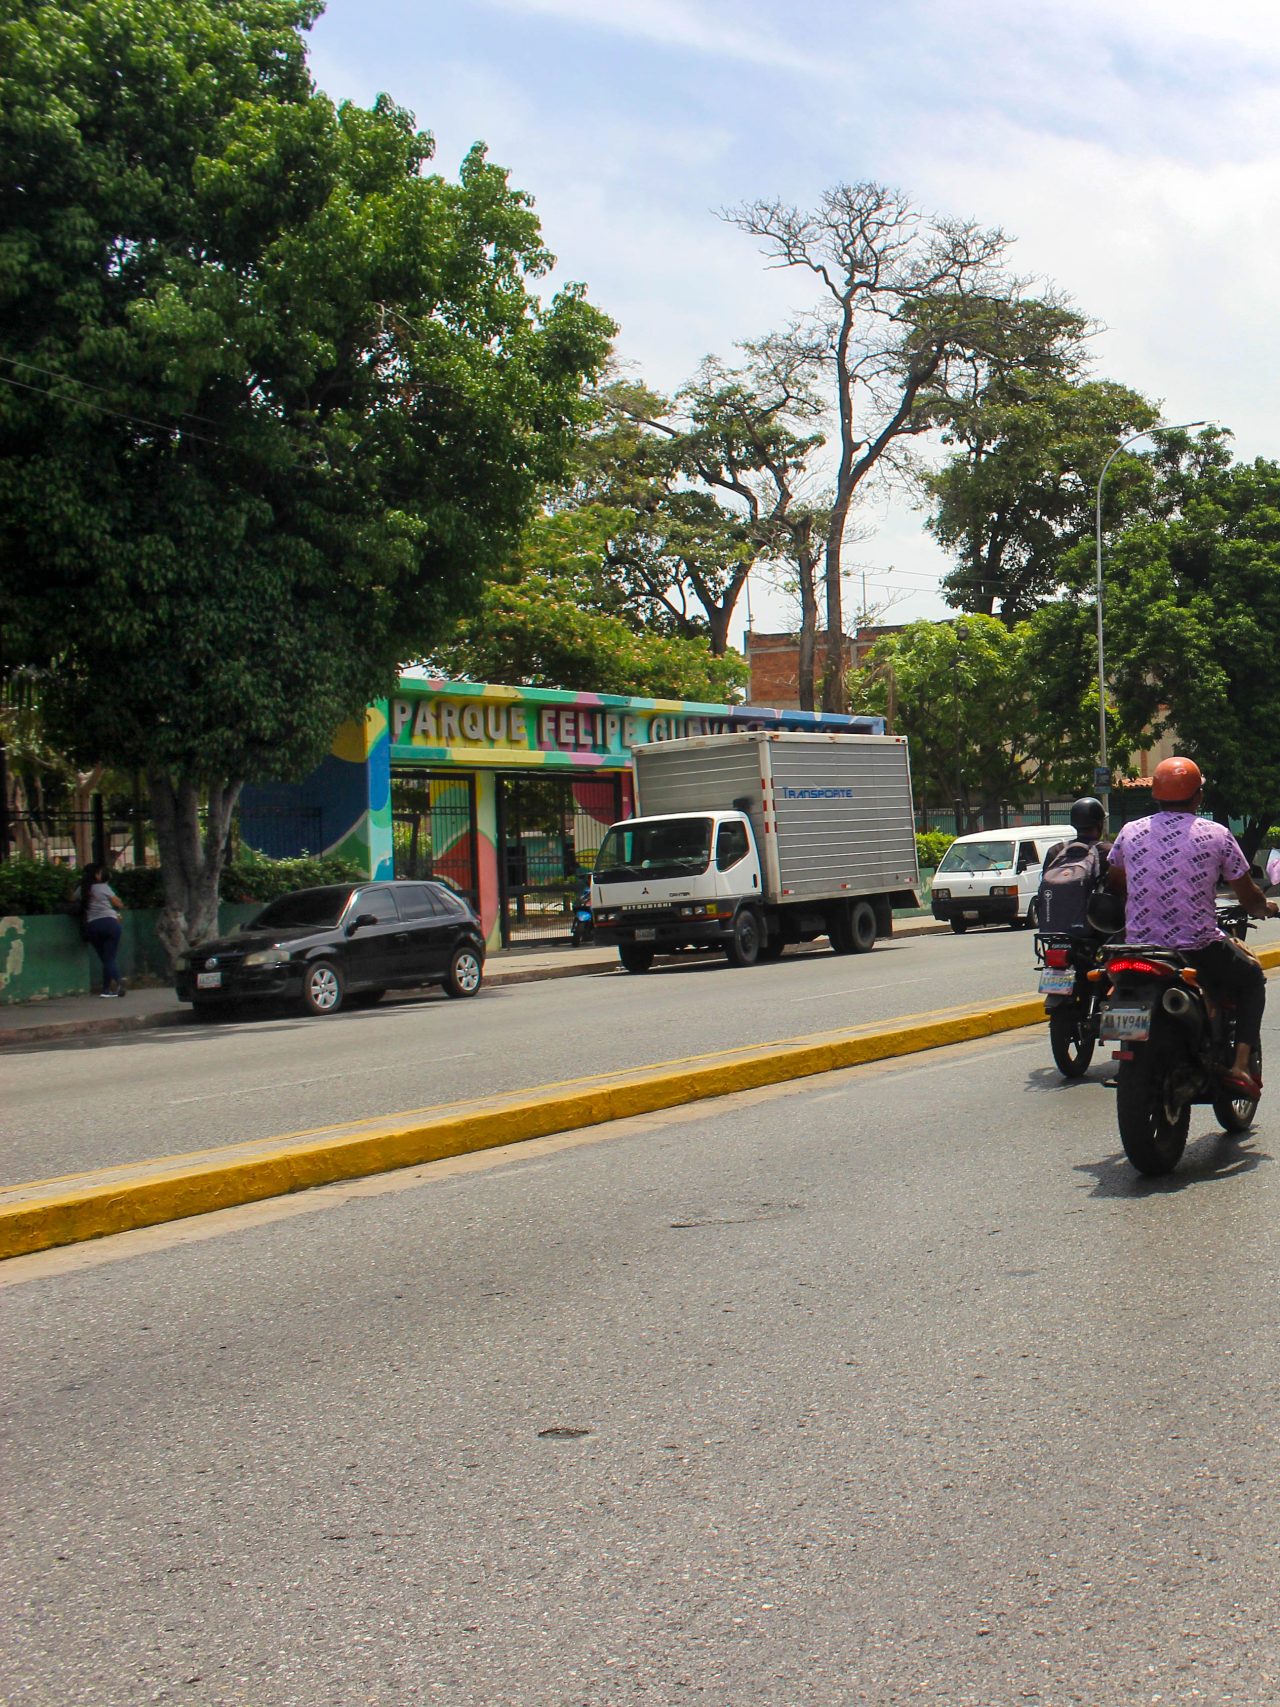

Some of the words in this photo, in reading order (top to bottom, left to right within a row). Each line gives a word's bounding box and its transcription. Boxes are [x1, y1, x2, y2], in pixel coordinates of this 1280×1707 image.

[392, 700, 527, 743] PARQUE
[540, 709, 639, 747] FELIPE
[622, 902, 671, 911] MITSUBISHI
